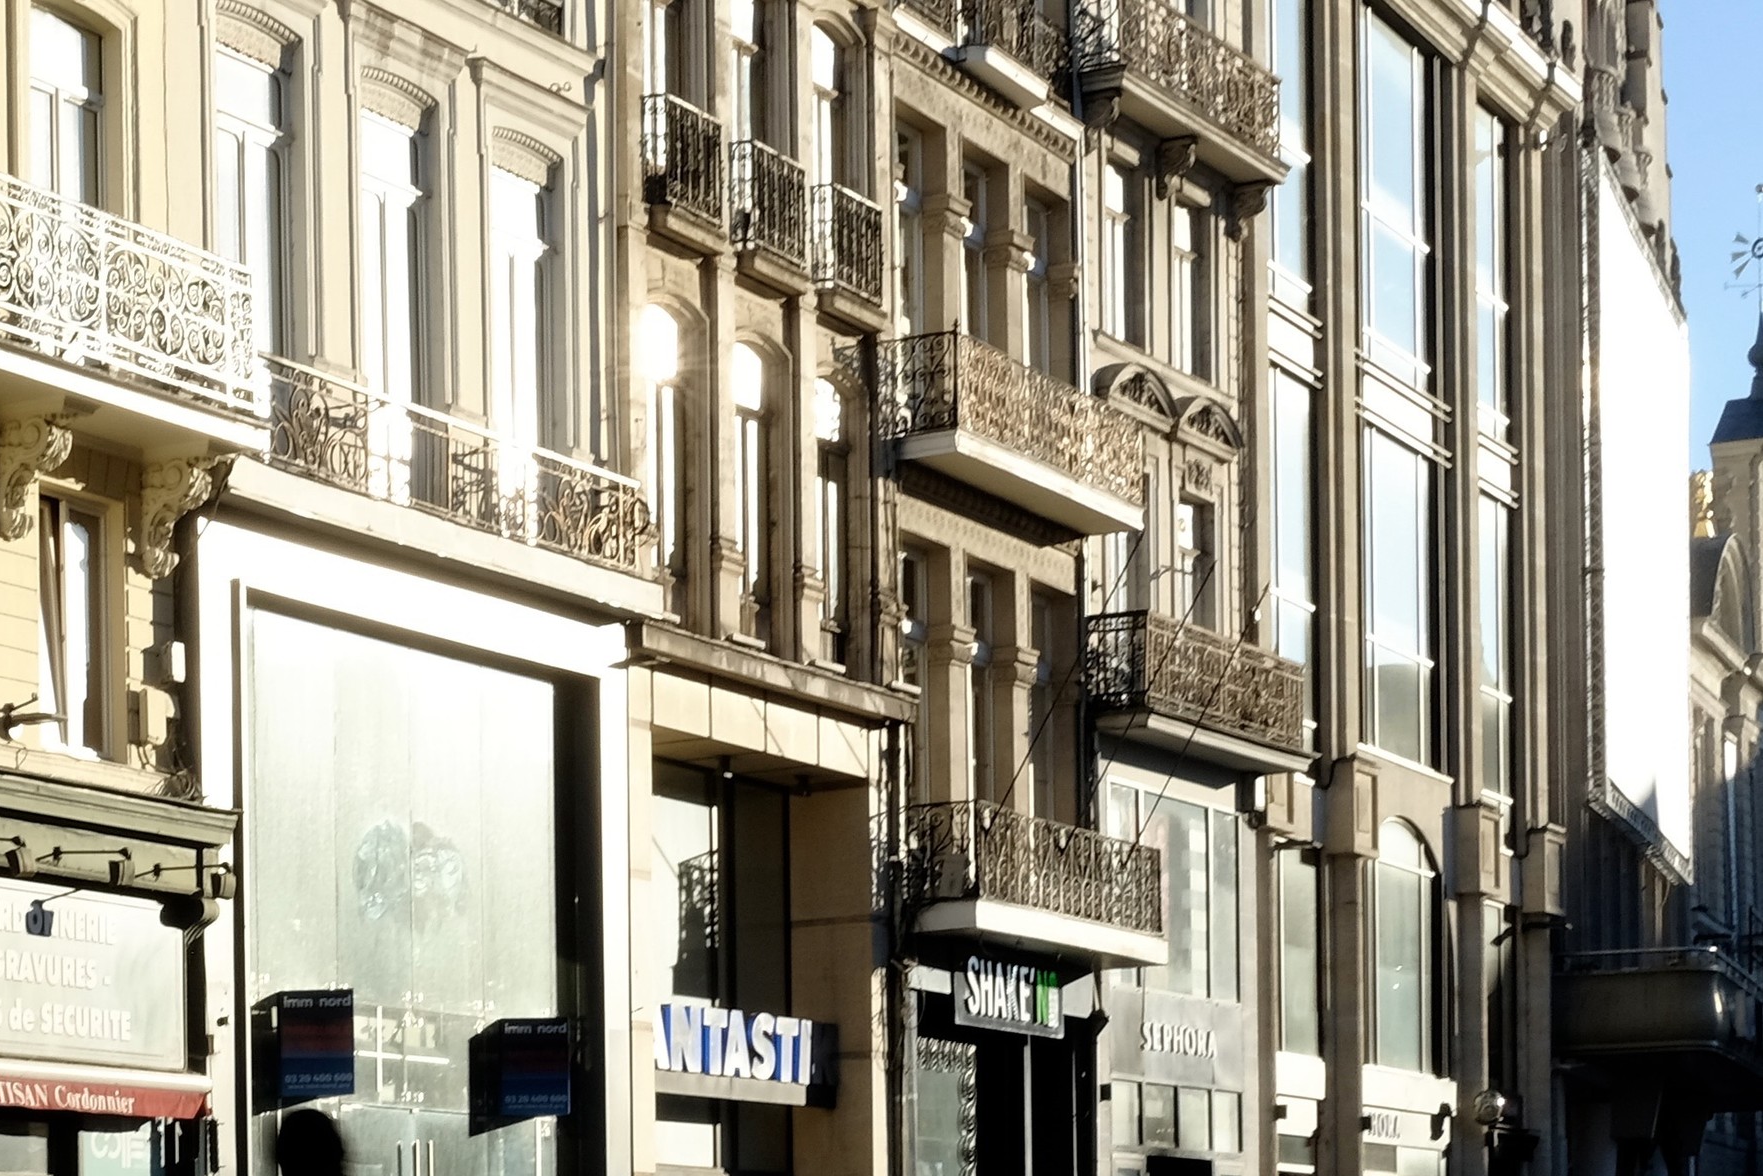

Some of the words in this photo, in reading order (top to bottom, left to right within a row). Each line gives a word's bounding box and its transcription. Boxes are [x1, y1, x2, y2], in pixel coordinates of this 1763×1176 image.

[319, 994, 351, 1008] nord
[8, 999, 35, 1033] de
[40, 1000, 132, 1042] SECURITE
[537, 1022, 567, 1035] nord
[1140, 1021, 1218, 1060] SEPHORA
[54, 1084, 136, 1115] Cordonnier
